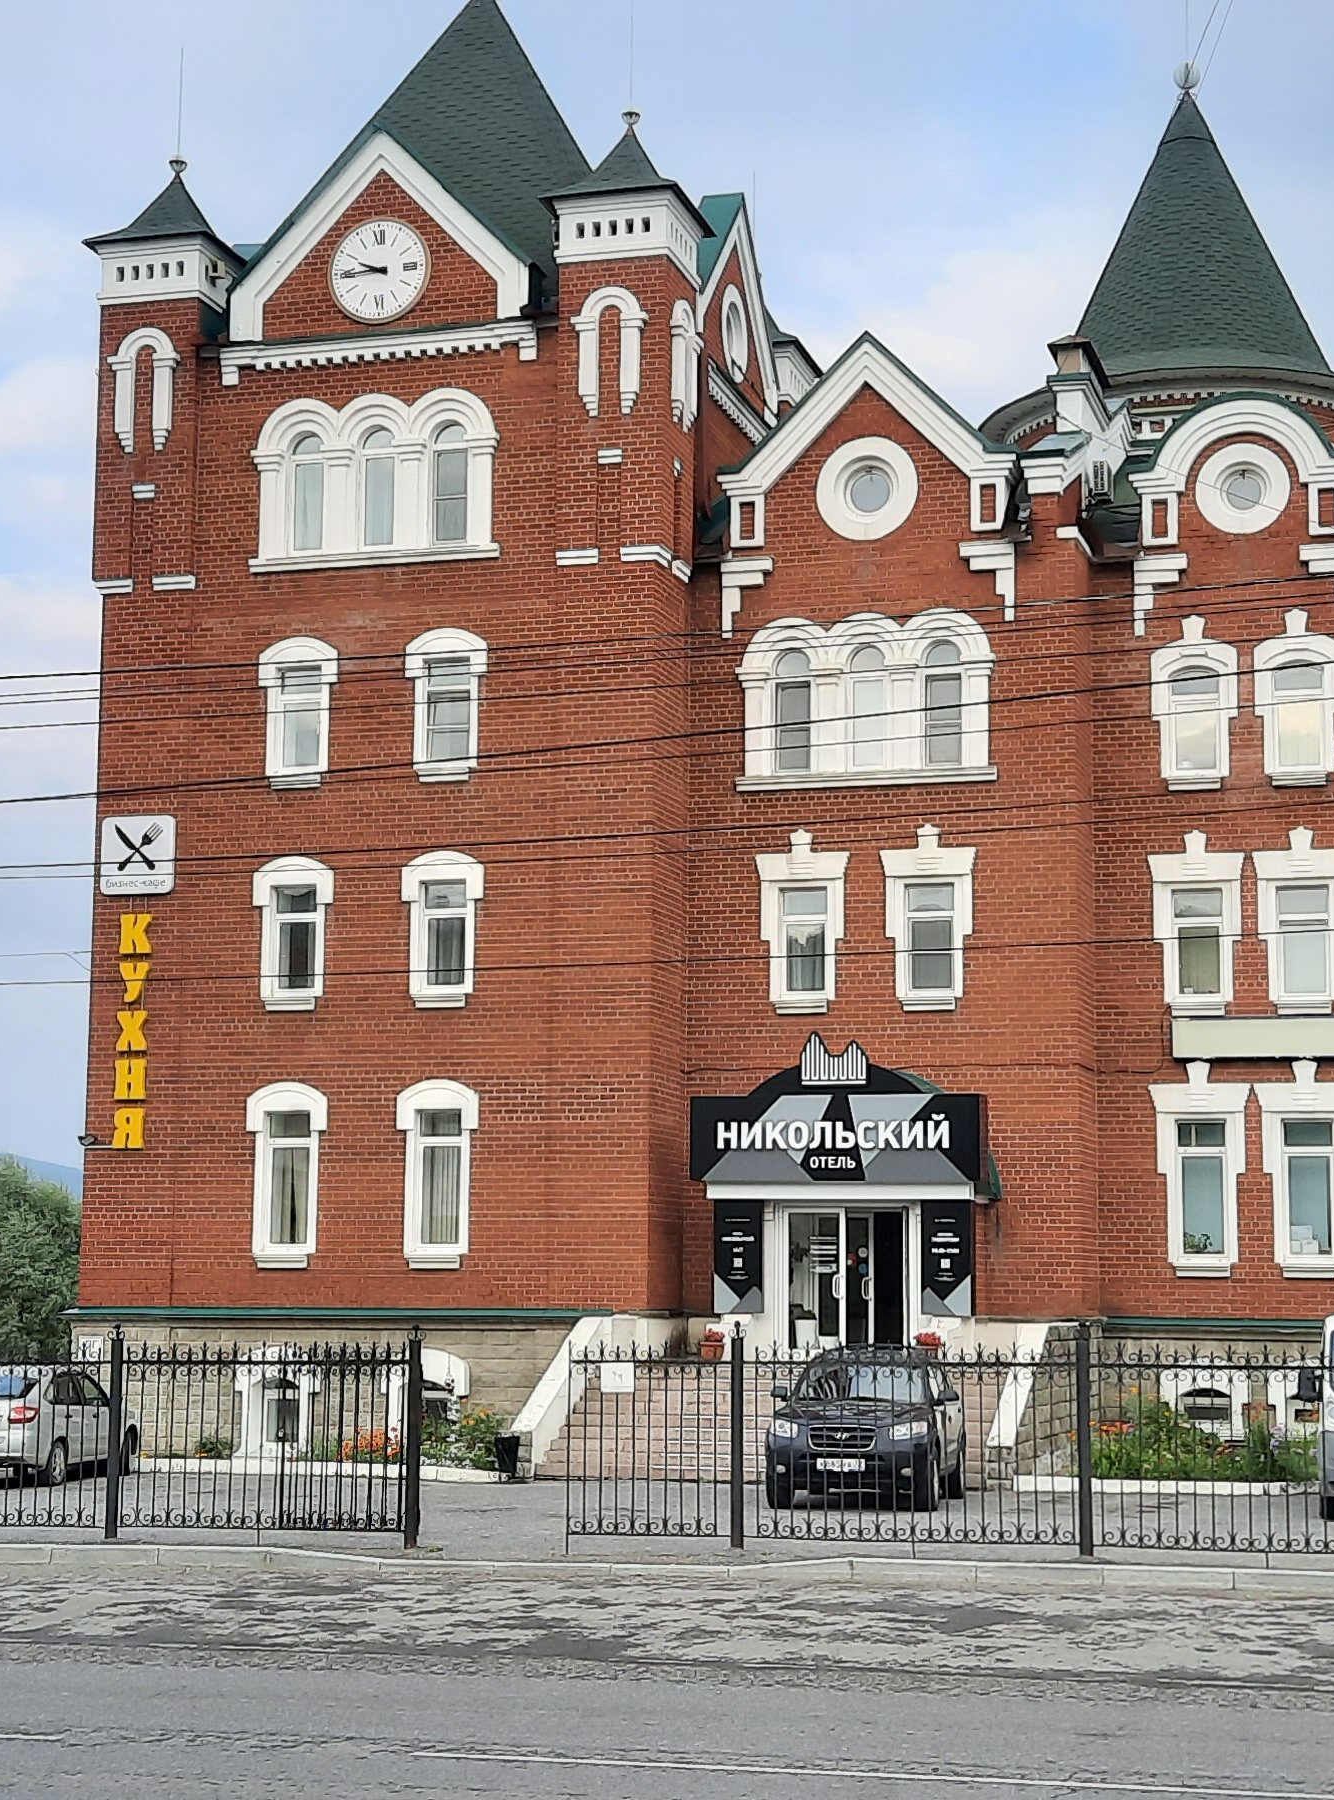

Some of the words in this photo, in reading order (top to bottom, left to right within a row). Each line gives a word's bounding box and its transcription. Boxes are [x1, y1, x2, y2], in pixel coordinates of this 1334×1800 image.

[112, 913, 153, 1150] КУХНЯ
[716, 1113, 950, 1150] НИКОЛЬСКИЙ
[809, 1156, 857, 1169] ОТЕЛЬ
